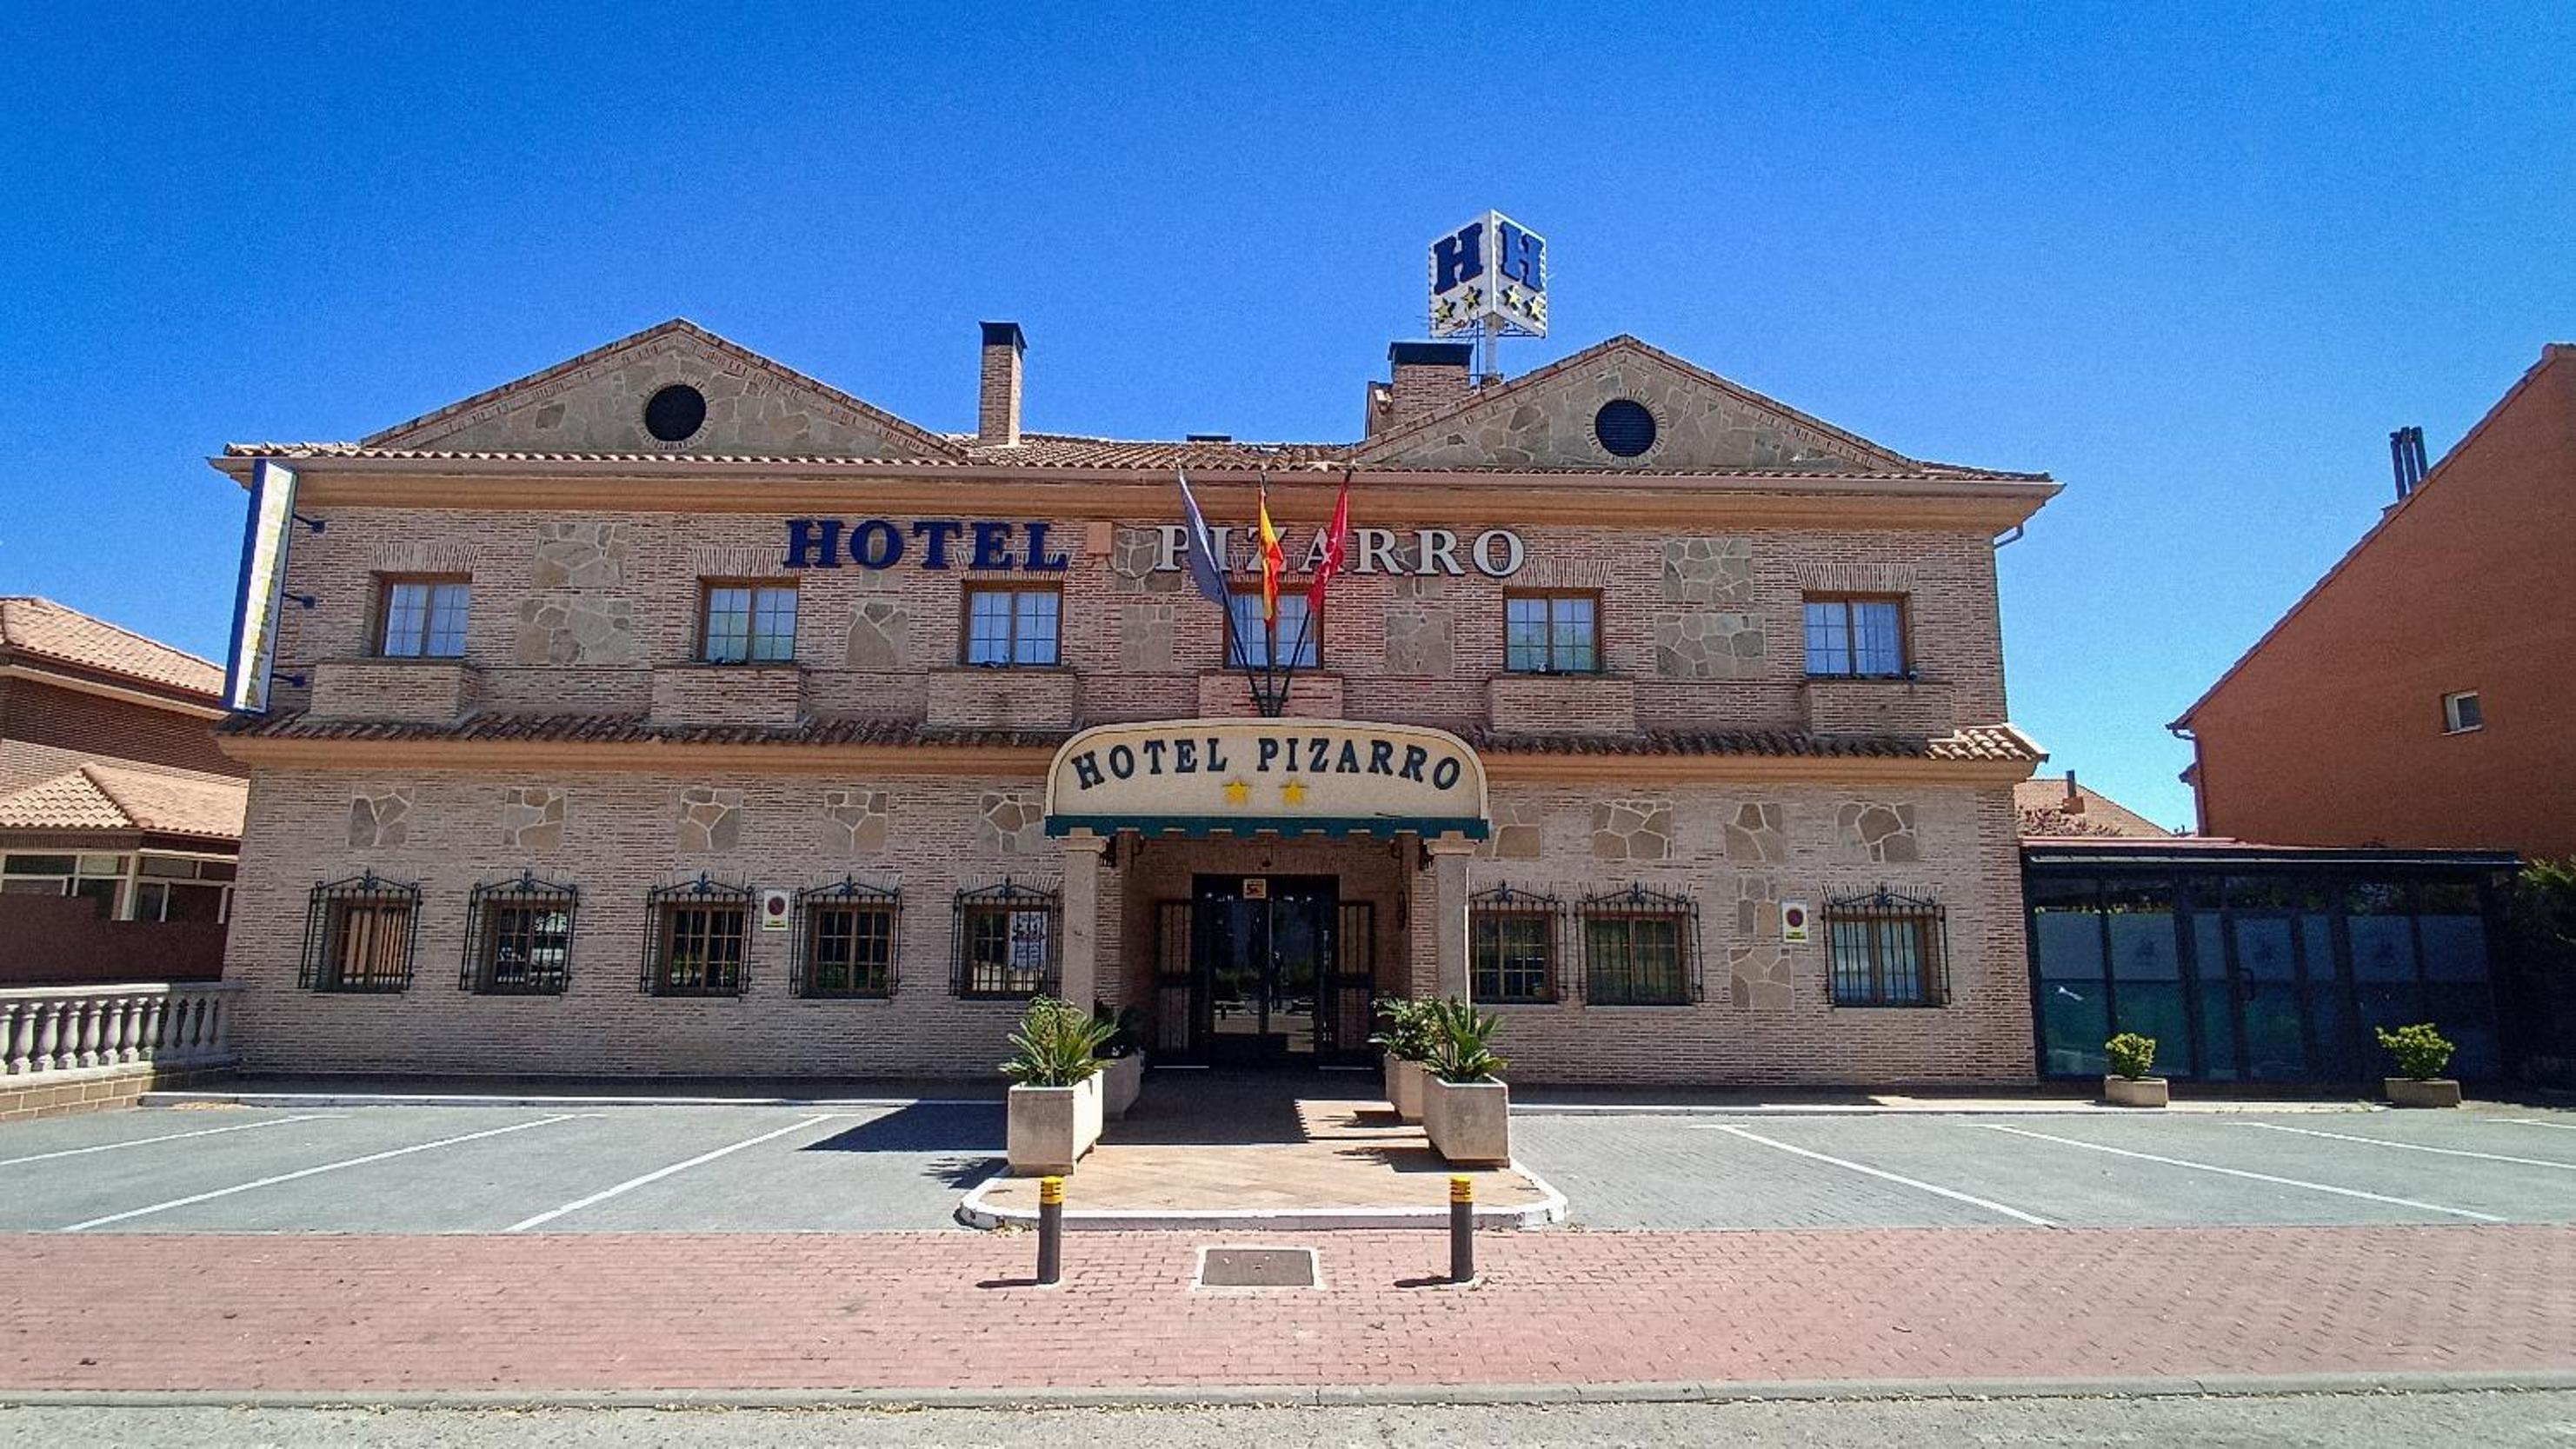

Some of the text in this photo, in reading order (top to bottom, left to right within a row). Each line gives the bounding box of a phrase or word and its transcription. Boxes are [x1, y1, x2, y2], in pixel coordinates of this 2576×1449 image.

[1434, 223, 1483, 295] H
[1499, 221, 1545, 293] H
[782, 520, 1069, 570] HOTEL
[1070, 738, 1461, 790] HOTEL PIZARRO
